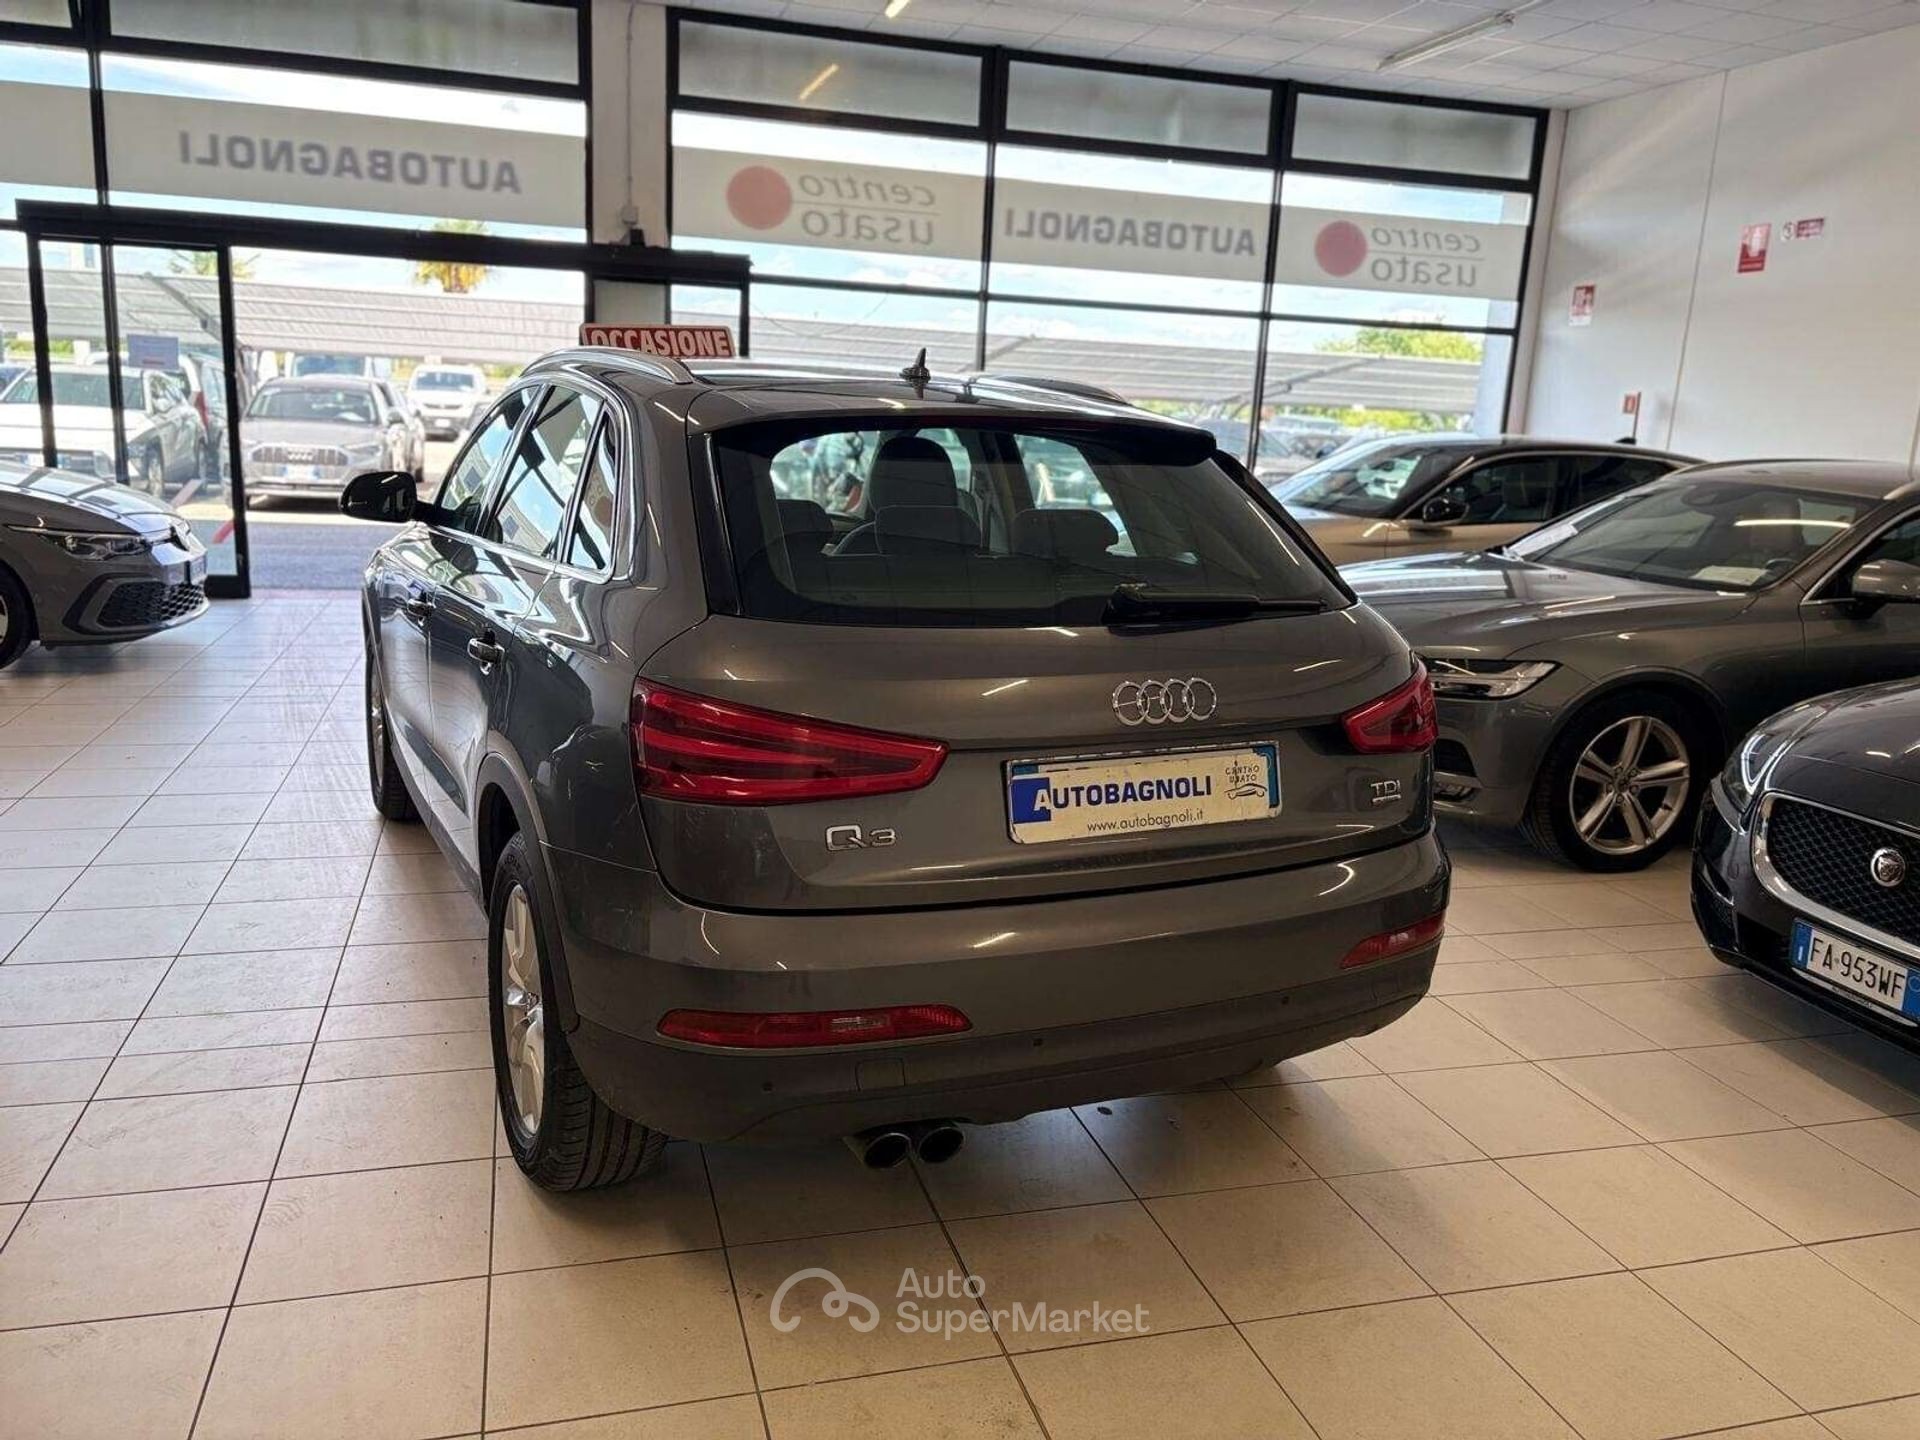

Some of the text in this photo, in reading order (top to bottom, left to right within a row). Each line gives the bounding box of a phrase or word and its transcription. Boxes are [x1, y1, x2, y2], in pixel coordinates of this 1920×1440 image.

[590, 329, 731, 357] OCCASIONE
[1034, 775, 1212, 812] AUTOBAGNOLI
[1370, 779, 1401, 796] TDI
[1087, 809, 1204, 833] www.autobagnoli.it
[826, 824, 896, 851] Q3
